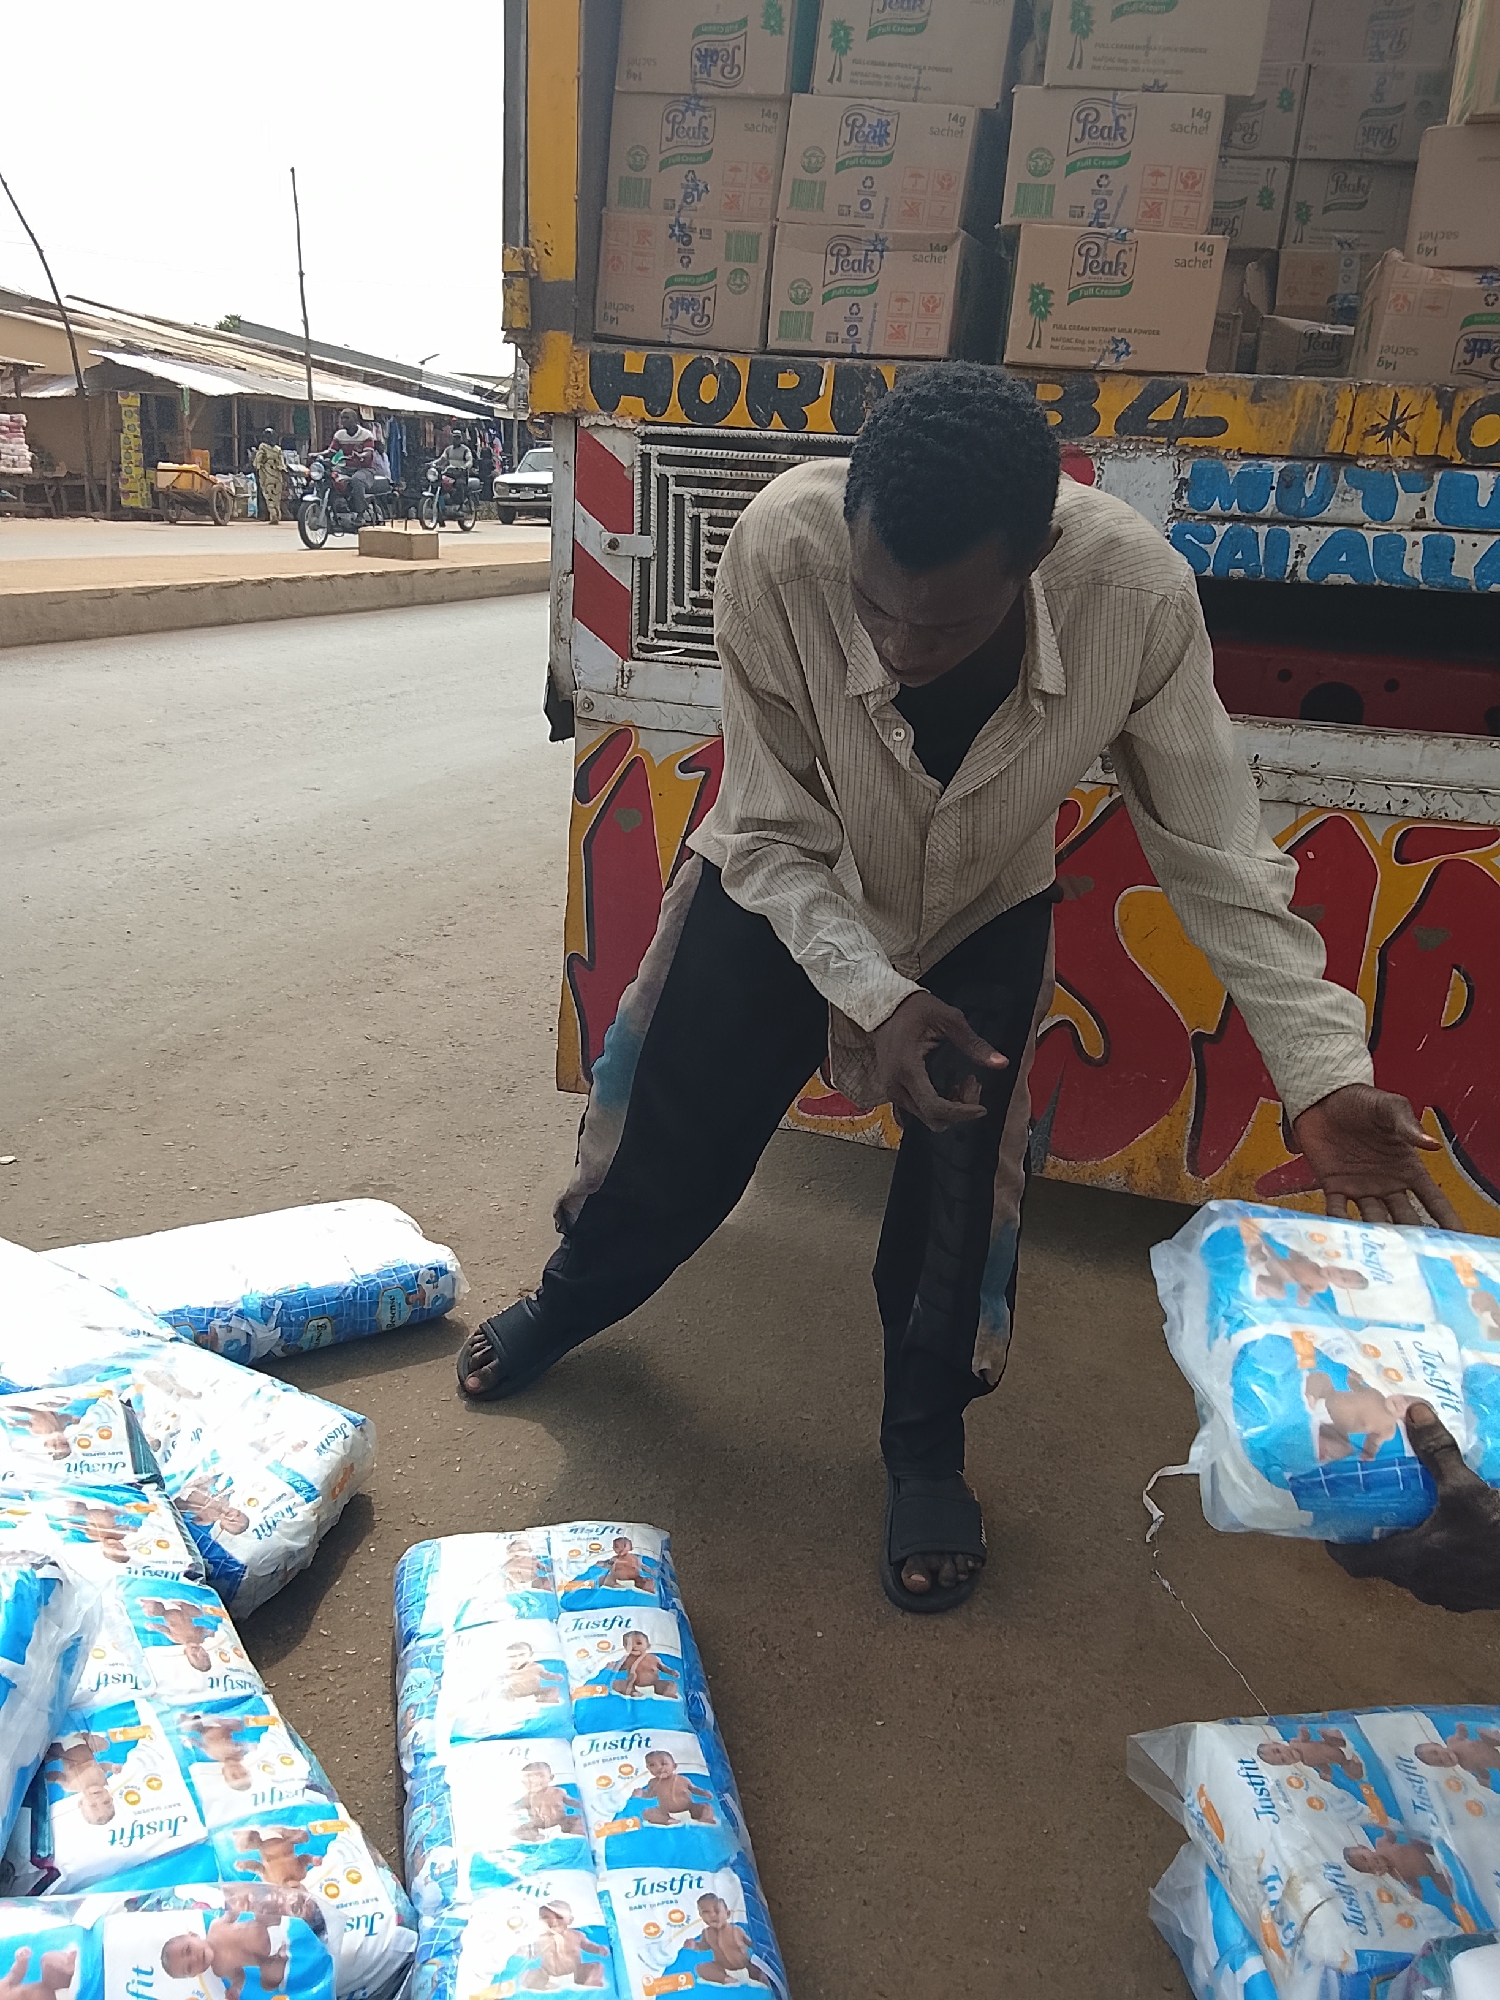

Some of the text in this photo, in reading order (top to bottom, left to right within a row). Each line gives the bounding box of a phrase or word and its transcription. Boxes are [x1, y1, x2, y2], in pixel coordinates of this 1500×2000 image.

[761, 108, 778, 121] 14g
[948, 113, 966, 127] 14g
[1191, 107, 1212, 124] 14g
[665, 108, 709, 142] Peak
[843, 112, 891, 146] Peak
[929, 126, 964, 138] sachet
[1074, 106, 1128, 144] Peak
[1170, 121, 1209, 136] sachet
[1093, 157, 1119, 167] Cream
[1418, 230, 1459, 242] sachet
[1193, 241, 1215, 256] 14g
[1416, 243, 1438, 257] 14g
[829, 243, 875, 275] Peak
[912, 253, 947, 264] sachet
[1076, 241, 1128, 277] Peak
[1174, 257, 1213, 269] sachet
[1079, 287, 1121, 297] Full Cream
[604, 301, 635, 313] sachet
[668, 296, 711, 328] Peak
[603, 313, 619, 325] 14g
[1380, 344, 1419, 356] sachet
[1376, 356, 1397, 371] 14g
[1169, 521, 1291, 581] SAI
[1412, 1340, 1463, 1415] Justfit
[564, 1614, 633, 1633] Justfit
[90, 1671, 143, 1692] Justf
[580, 1733, 652, 1757] Justfit
[602, 1755, 629, 1764] DIAPERS
[1237, 1758, 1280, 1825] Justfit
[1396, 1755, 1439, 1827] Justfit
[108, 1815, 188, 1848] Justfit
[624, 1872, 705, 1899] Justfit
[336, 1901, 360, 1910] DIAPER
[629, 1899, 679, 1912] BABY DIAPERS
[1323, 1861, 1368, 1937] Justfit
[677, 1974, 687, 1985] 9
